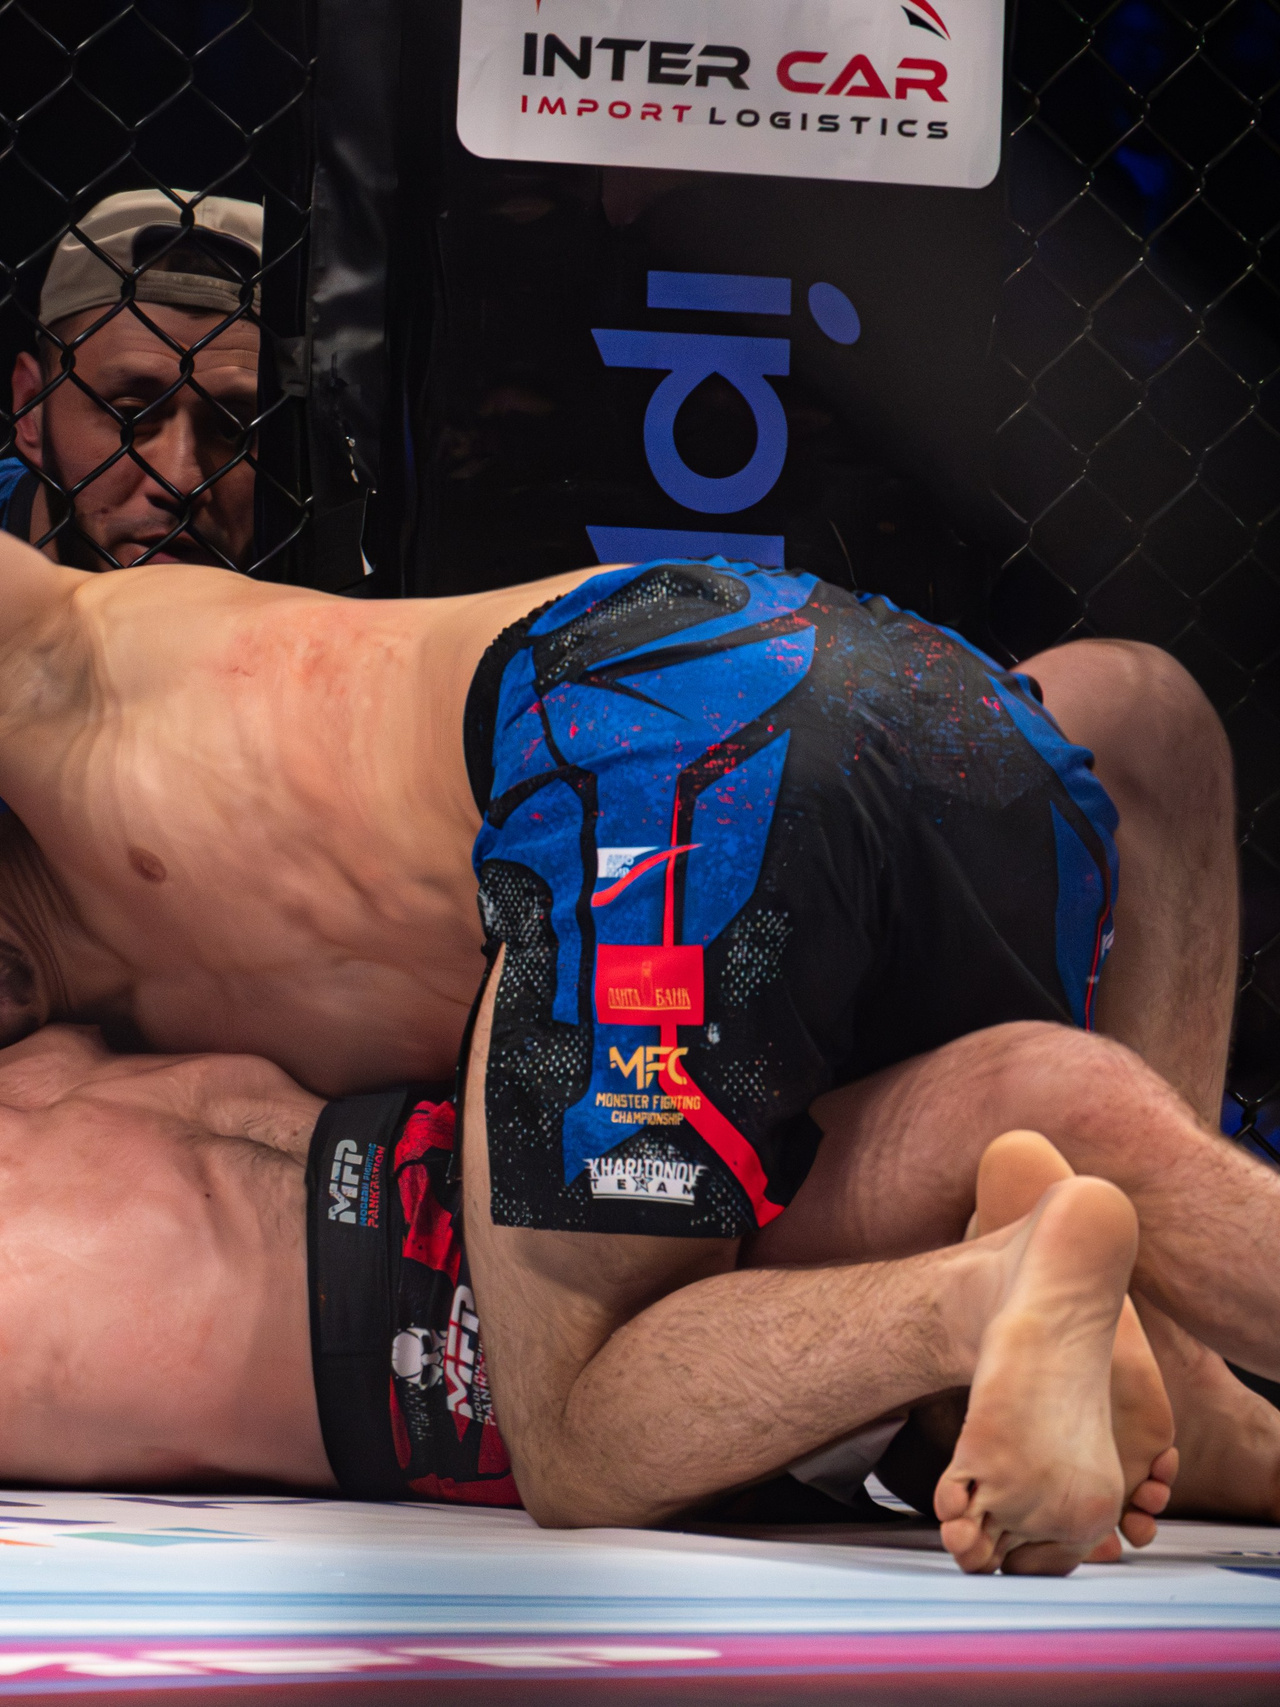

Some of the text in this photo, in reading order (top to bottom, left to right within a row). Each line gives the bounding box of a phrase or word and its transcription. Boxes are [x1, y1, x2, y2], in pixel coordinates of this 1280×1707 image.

[522, 32, 949, 103] INTER CAR
[521, 95, 949, 139] IMPORT LOGISTICS
[609, 1045, 689, 1090] MFC
[595, 1092, 701, 1110] MONSTER FIGHTING
[611, 1110, 684, 1125] CHAMPIONSHIP
[328, 1139, 363, 1224] MFP
[359, 1143, 376, 1226] MODERN FIGHTING
[368, 1145, 386, 1228] PANKRATION
[584, 1158, 708, 1187] KHARITONOV
[446, 1285, 480, 1420] MFP
